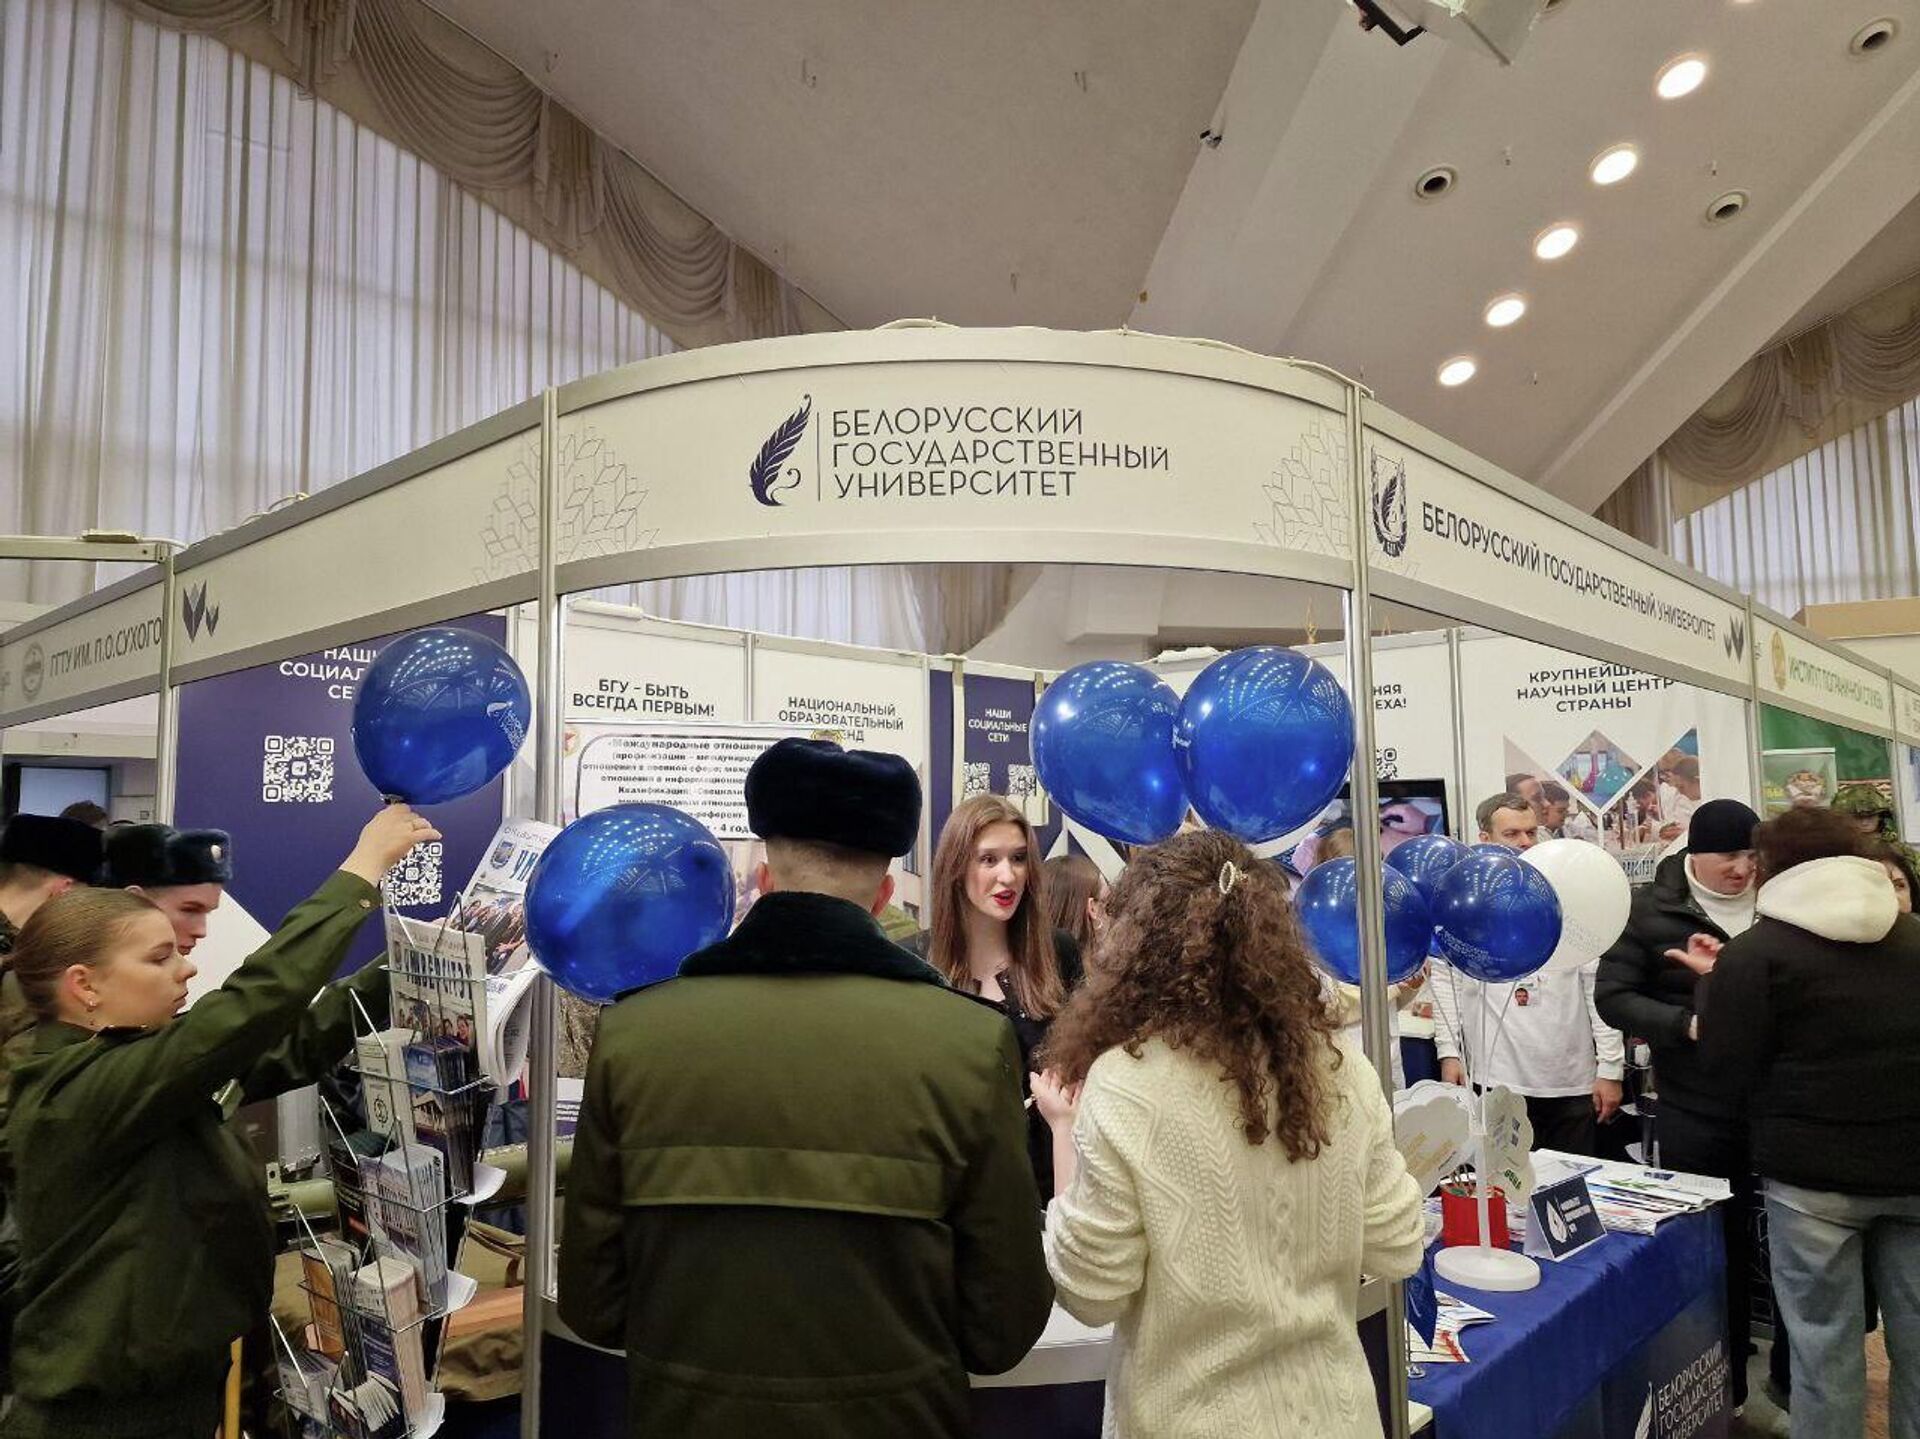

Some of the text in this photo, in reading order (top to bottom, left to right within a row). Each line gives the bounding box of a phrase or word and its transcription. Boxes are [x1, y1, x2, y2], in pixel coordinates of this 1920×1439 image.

[833, 406, 1082, 438] БЕЛОРУССКИЙ
[833, 439, 1169, 471] ГОСУДАРСТВЕННЫЙ
[834, 470, 1077, 499] УНИВЕРСИТЕТ
[1422, 501, 1717, 641] БЕЛОРУССКИЙ ГОСУДАРСТВЕННЫЙ УНИВЕРСИТЕТ
[328, 685, 354, 700] СЕ
[599, 679, 629, 694] БГУ
[645, 683, 689, 699] БЫТЬ
[1373, 684, 1401, 695] НЯЯ
[1517, 676, 1675, 700] НАУЧНЫЙ ЦЕНТР
[573, 693, 715, 717] ВСЕГДА ПЕРВЫМ!
[788, 696, 896, 716] НАЦИОНАЛЬНЫЙ
[985, 708, 1012, 719] НАШИ
[1376, 698, 1407, 709] ЕХА!
[1556, 697, 1632, 712] СТРАНЫ
[778, 709, 904, 731] ОБРАЗОВАТЕЛЬНЫЙ
[968, 719, 1027, 733] СОЦИАЛЬНЫЕ
[988, 733, 1010, 743] СЕТИ
